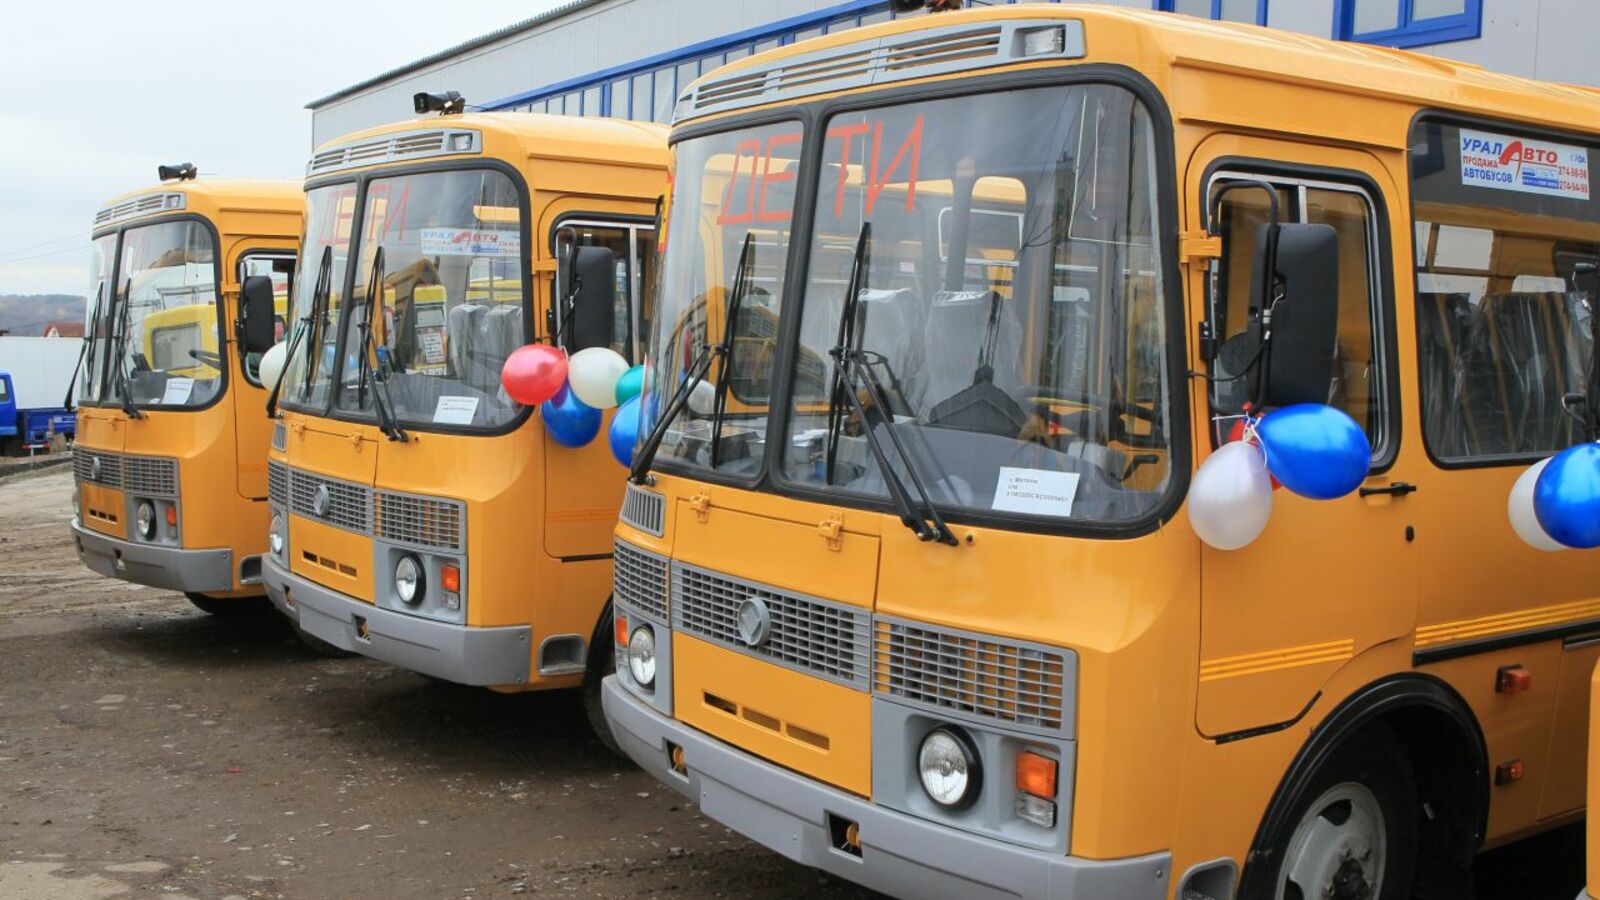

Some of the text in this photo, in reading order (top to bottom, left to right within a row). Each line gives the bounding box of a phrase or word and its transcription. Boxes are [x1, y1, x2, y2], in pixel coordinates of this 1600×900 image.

[1462, 138, 1503, 155] УРАЛ
[1463, 155, 1499, 168] ПРОДАЖА
[717, 115, 924, 225] ДЕТИ
[1463, 167, 1513, 183] АВТОБУСОВ
